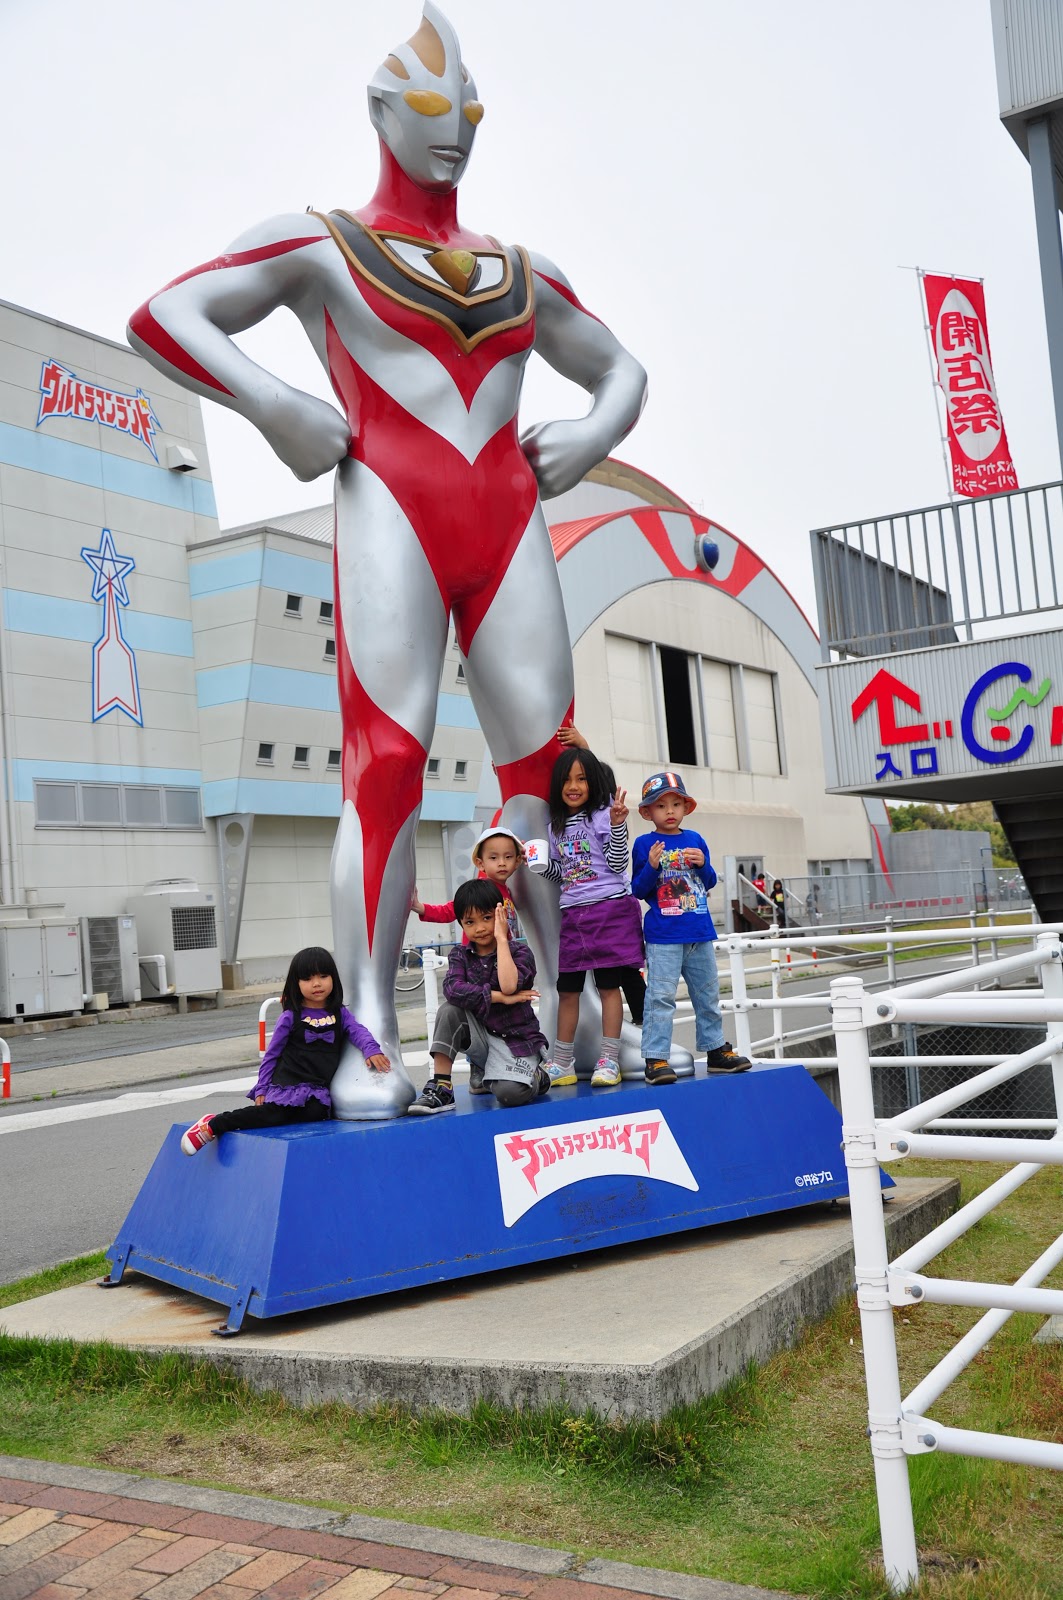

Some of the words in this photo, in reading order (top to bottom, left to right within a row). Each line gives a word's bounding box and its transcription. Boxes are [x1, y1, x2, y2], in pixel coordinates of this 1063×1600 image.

[876, 747, 939, 781] 入口
[504, 1120, 662, 1196] ウルトラマンガイア
